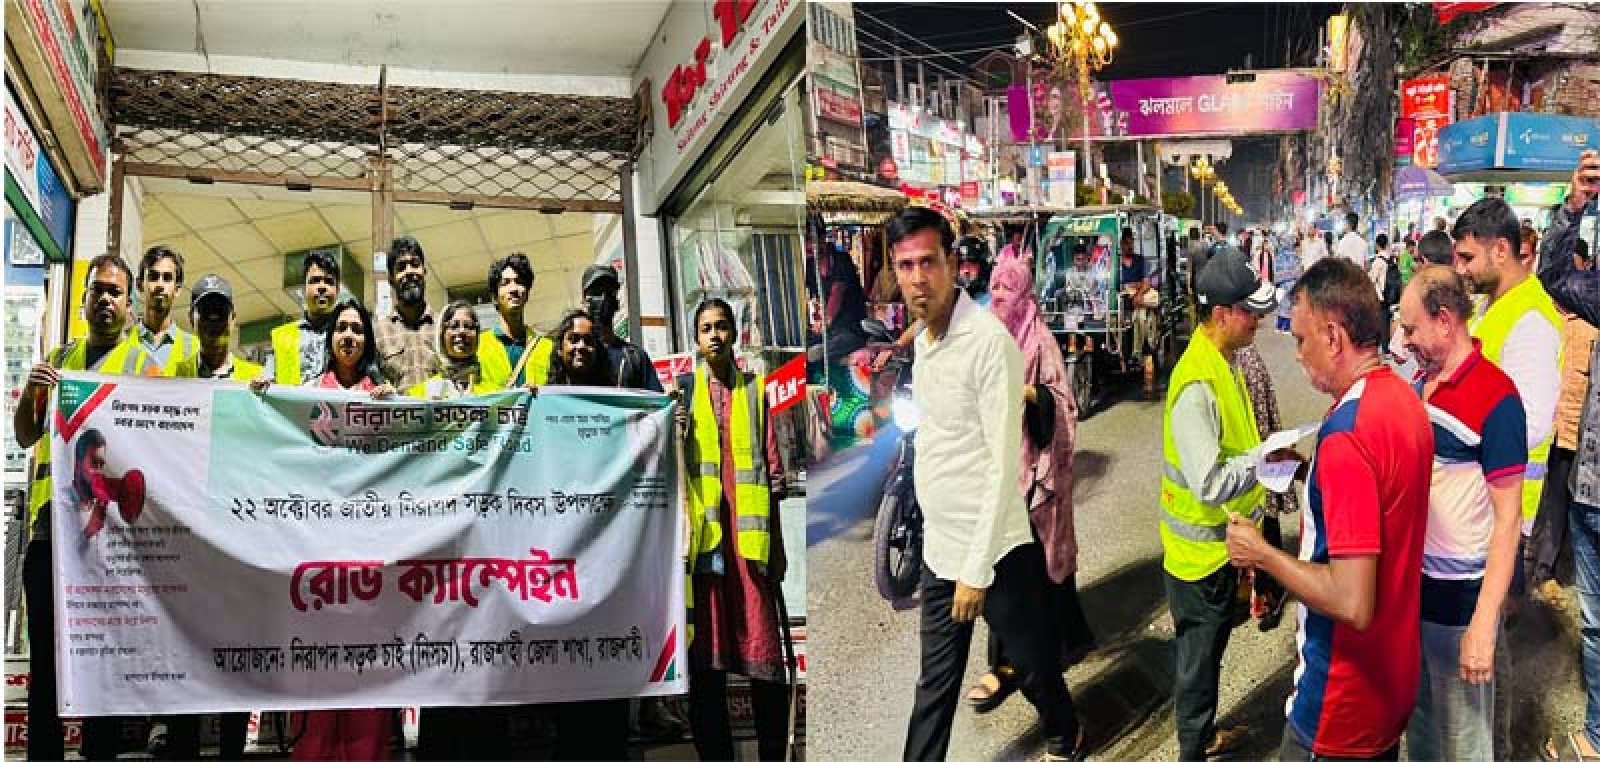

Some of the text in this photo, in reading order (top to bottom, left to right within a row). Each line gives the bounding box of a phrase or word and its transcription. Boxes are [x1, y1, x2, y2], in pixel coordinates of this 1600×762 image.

[344, 402, 528, 431] নিরাপদ সড়ক চাই
[345, 438, 369, 455] We
[377, 436, 447, 454] Demand
[231, 497, 257, 521] ২২
[264, 491, 332, 520] অক্টোবর
[340, 490, 392, 519] জাতীয়
[399, 490, 457, 518] নিরাপদ
[464, 493, 502, 519] সড়ক
[508, 488, 546, 516] দিবস
[290, 547, 579, 612] রোড ক্যাম্পেইন
[290, 637, 340, 671] নিরাপদ
[344, 643, 379, 674] সড়ক
[381, 633, 406, 671] চাই
